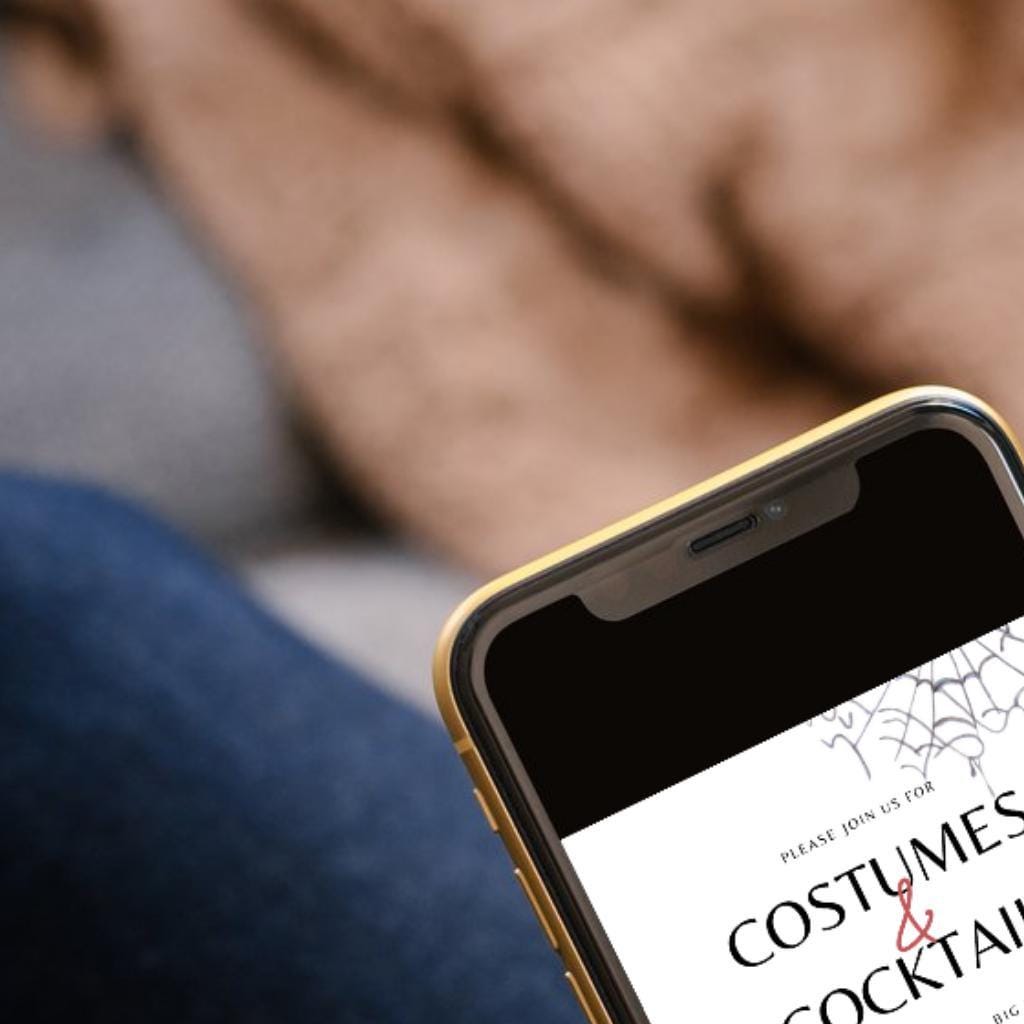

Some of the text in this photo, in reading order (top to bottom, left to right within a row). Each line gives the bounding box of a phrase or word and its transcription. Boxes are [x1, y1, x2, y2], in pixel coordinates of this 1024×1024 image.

[780, 780, 935, 864] PLEASE JOIN US FOR
[896, 878, 936, 952] &
